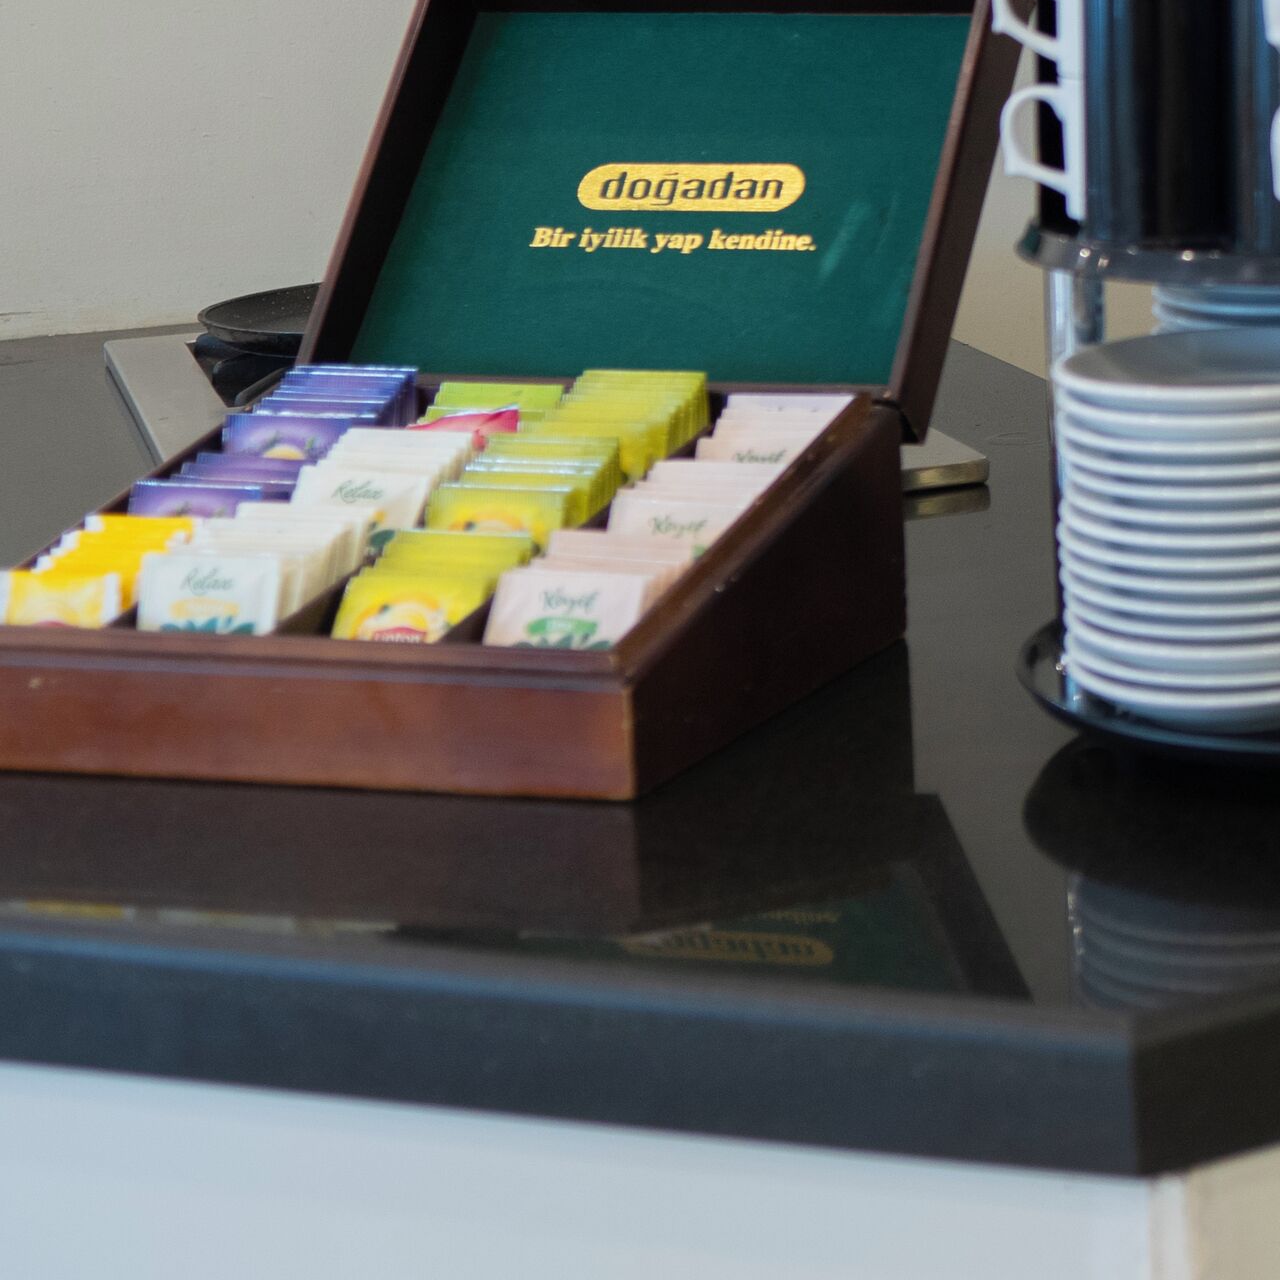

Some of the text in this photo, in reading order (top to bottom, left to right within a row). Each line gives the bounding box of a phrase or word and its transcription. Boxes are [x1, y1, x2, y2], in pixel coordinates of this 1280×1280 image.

[598, 170, 785, 207] doğadan
[529, 225, 817, 254] Bir iyilik yap kendine.
